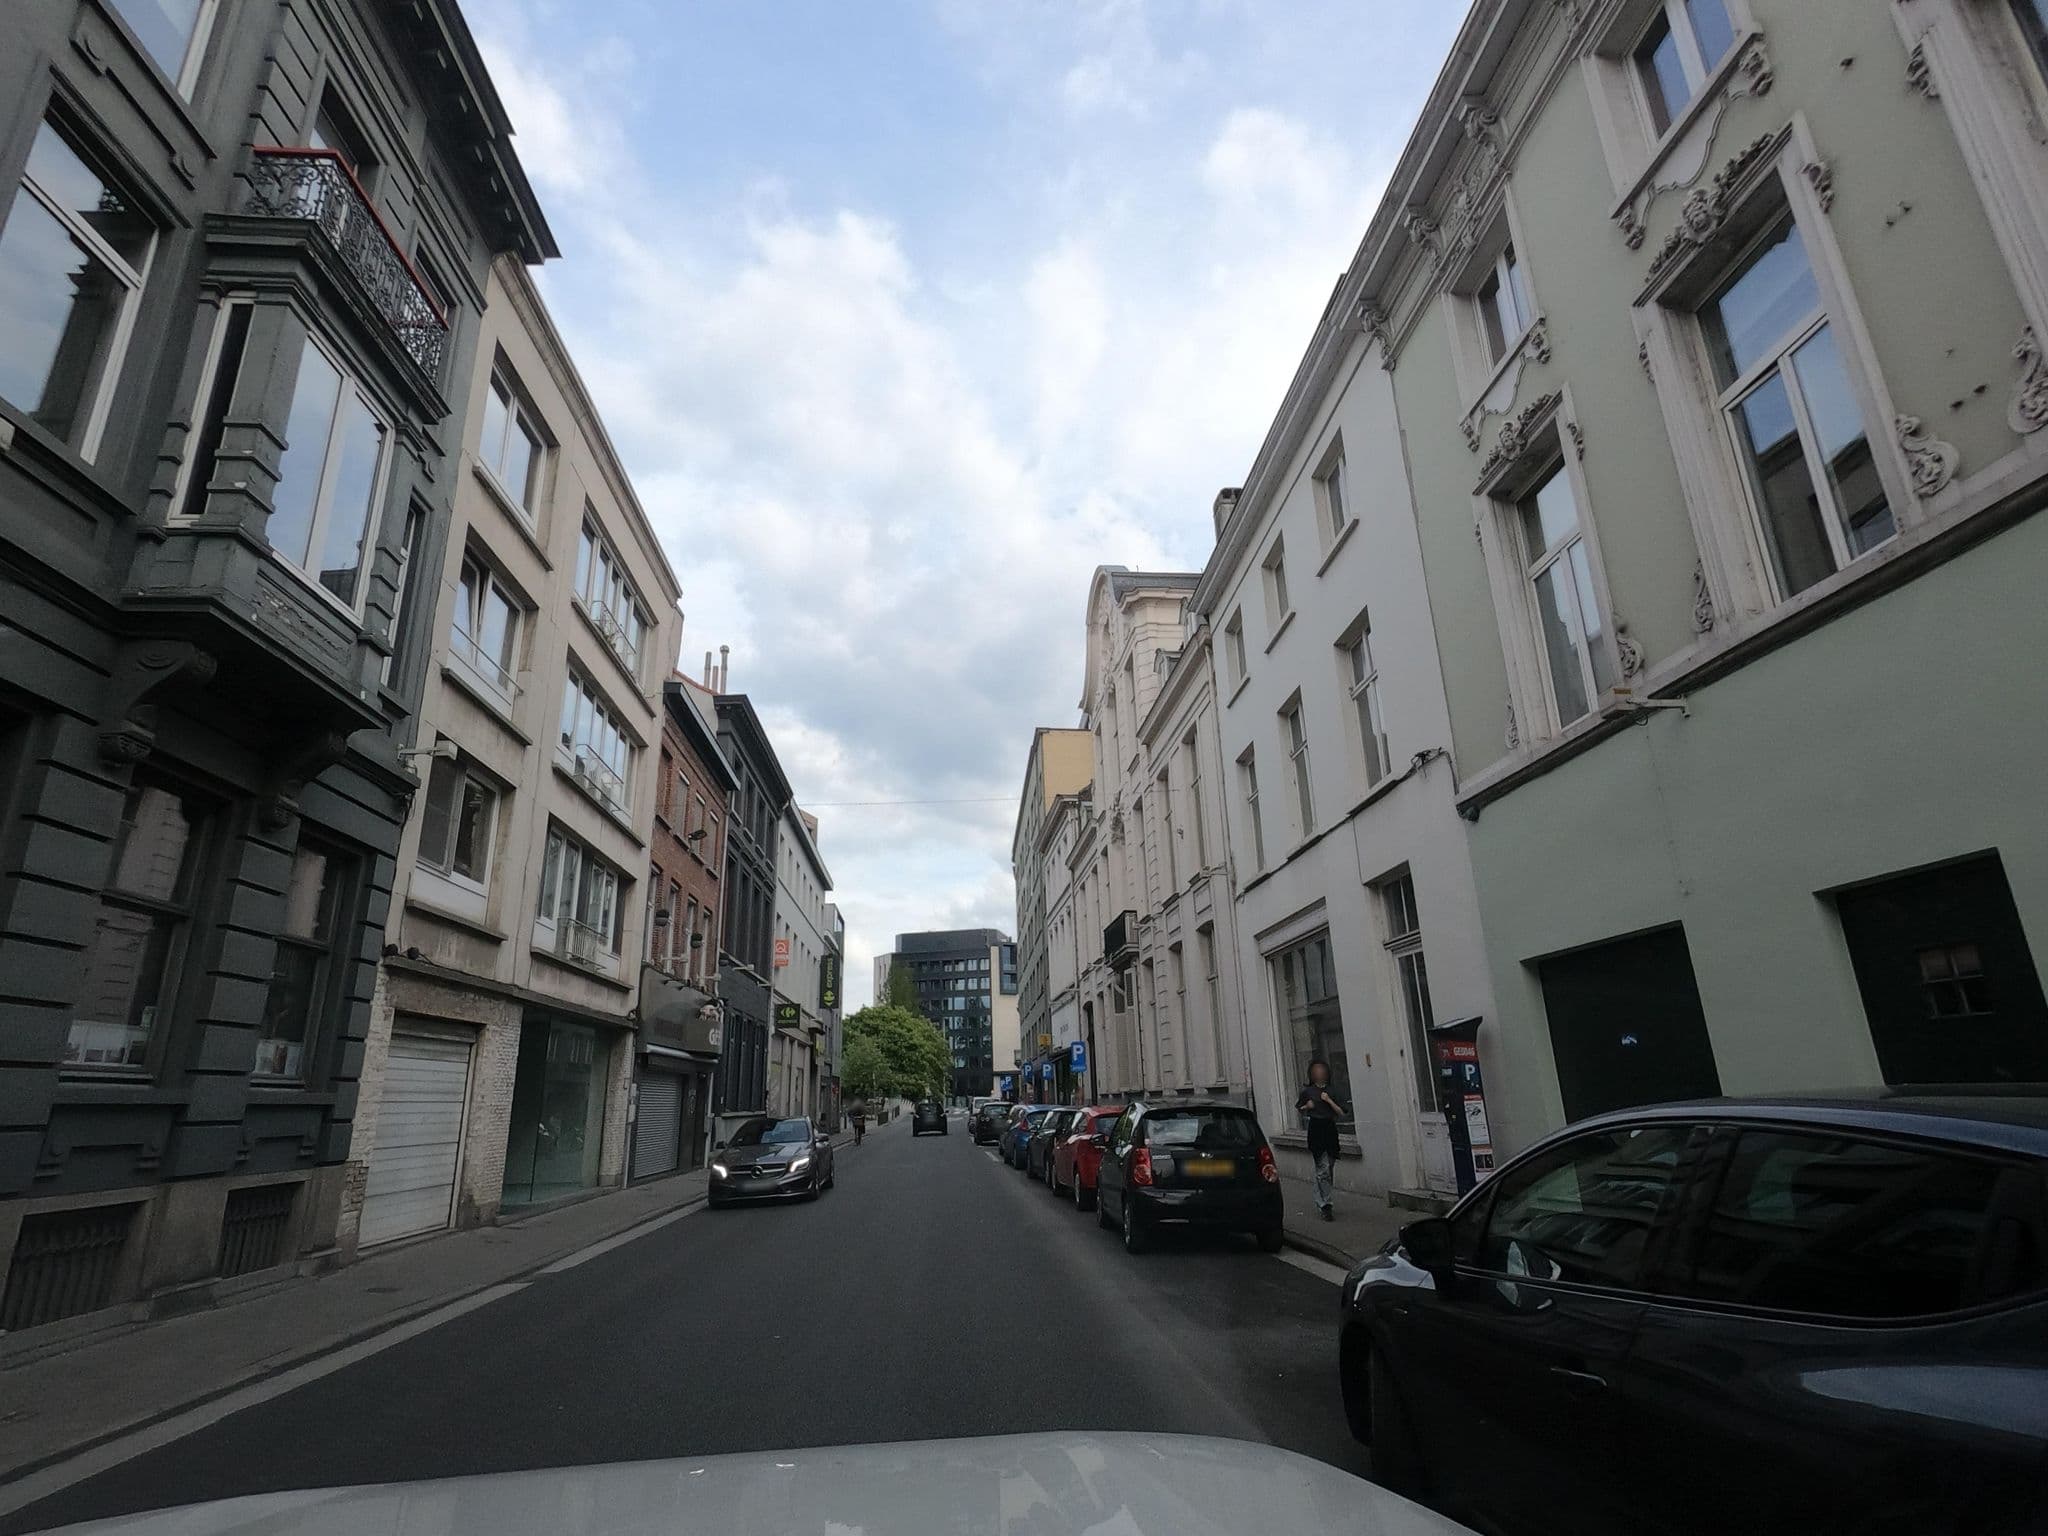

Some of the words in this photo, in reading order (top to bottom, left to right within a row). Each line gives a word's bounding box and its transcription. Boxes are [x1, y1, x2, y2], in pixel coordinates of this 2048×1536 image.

[826, 957, 834, 988] express
[1073, 1045, 1084, 1061] P
[1025, 1065, 1032, 1076] P
[1043, 1065, 1051, 1077] P
[1465, 1064, 1476, 1081] P
